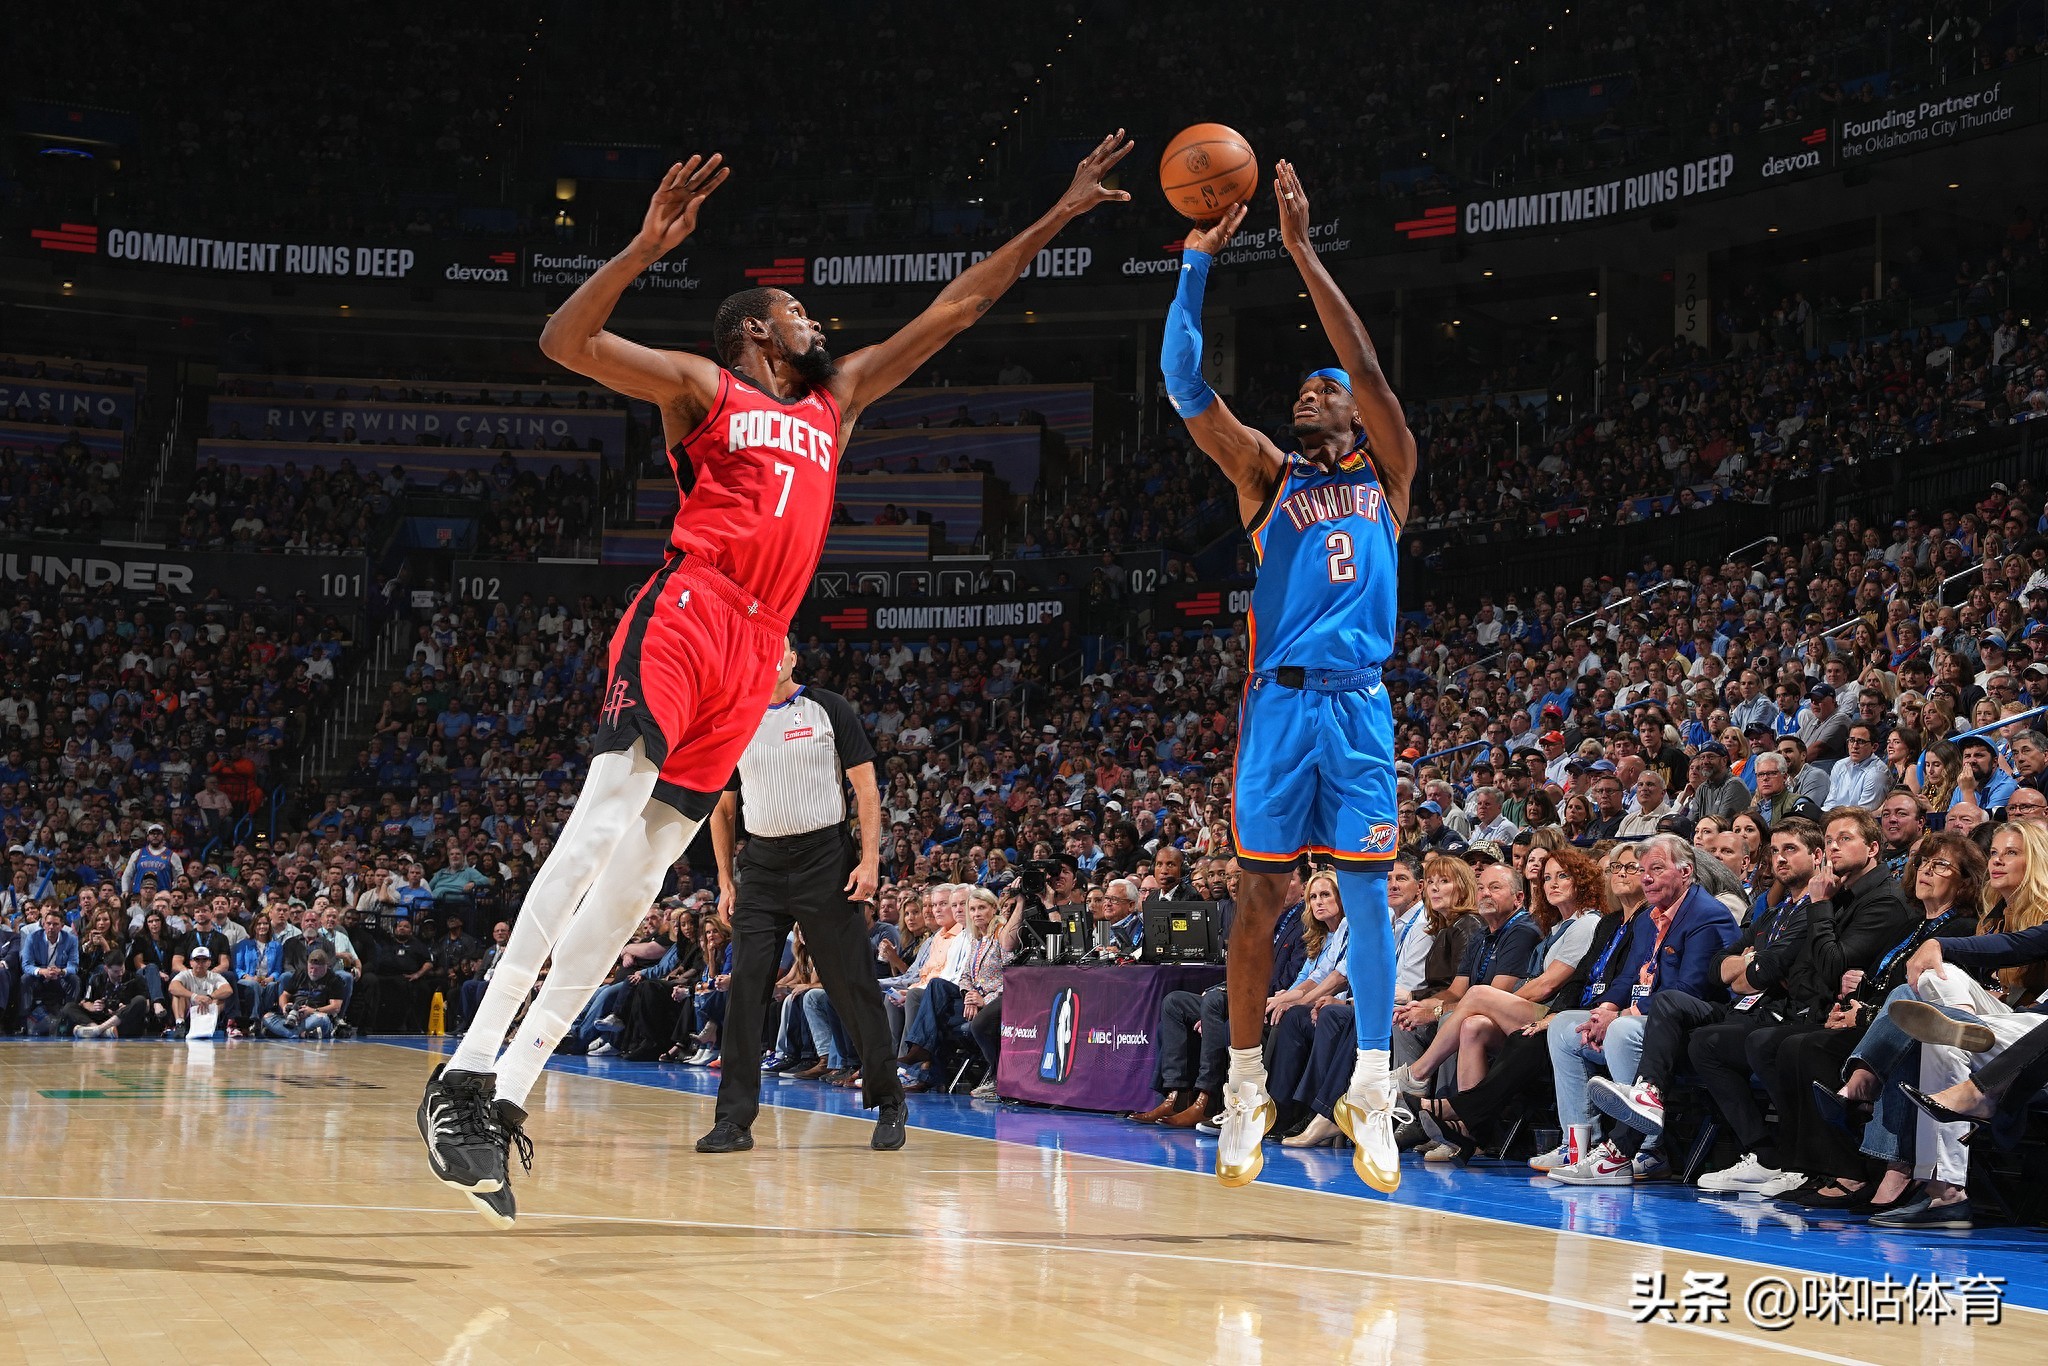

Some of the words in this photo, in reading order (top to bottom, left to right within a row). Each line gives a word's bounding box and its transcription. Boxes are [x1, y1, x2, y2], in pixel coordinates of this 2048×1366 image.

[1843, 109, 1916, 138] Founding
[1919, 93, 1980, 120] Partner
[1983, 82, 2001, 102] of
[1842, 144, 1863, 158] the
[1865, 126, 1928, 151] Oklahoma
[1931, 118, 1958, 139] City
[1960, 105, 2014, 130] Thunder
[1761, 150, 1821, 178] devon
[1465, 180, 1621, 234] COMMITMENT
[1624, 167, 1678, 210] RUNS
[1683, 153, 1734, 196] DEEP
[1324, 219, 1340, 236] of
[107, 228, 281, 272] COMMITMENT
[285, 244, 350, 276] RUNS
[355, 247, 415, 278] DEEP
[533, 254, 606, 270] Founding
[672, 258, 689, 273] of
[812, 252, 966, 286] COMMITMENT
[1036, 247, 1092, 278] DEEP
[1121, 257, 1181, 275] devon
[1220, 245, 1277, 265] Oklahoma
[445, 263, 509, 282] devon
[533, 271, 553, 284] the
[649, 275, 700, 290] Thunder
[1685, 273, 1697, 331] 205
[268, 408, 441, 432] RIVERWIND
[456, 416, 569, 437] CASINO
[729, 410, 833, 473] ROCKETS
[774, 461, 796, 518] 7
[1280, 484, 1382, 533] THUNDER
[1325, 531, 1356, 584] 2
[0, 553, 194, 594] UNDER
[321, 573, 361, 598] 101
[458, 576, 501, 600] 102
[876, 606, 984, 630] COMMITMENT
[985, 602, 1025, 626] RUNS
[785, 730, 812, 739] Emirates
[1116, 1030, 1149, 1049] peacock
